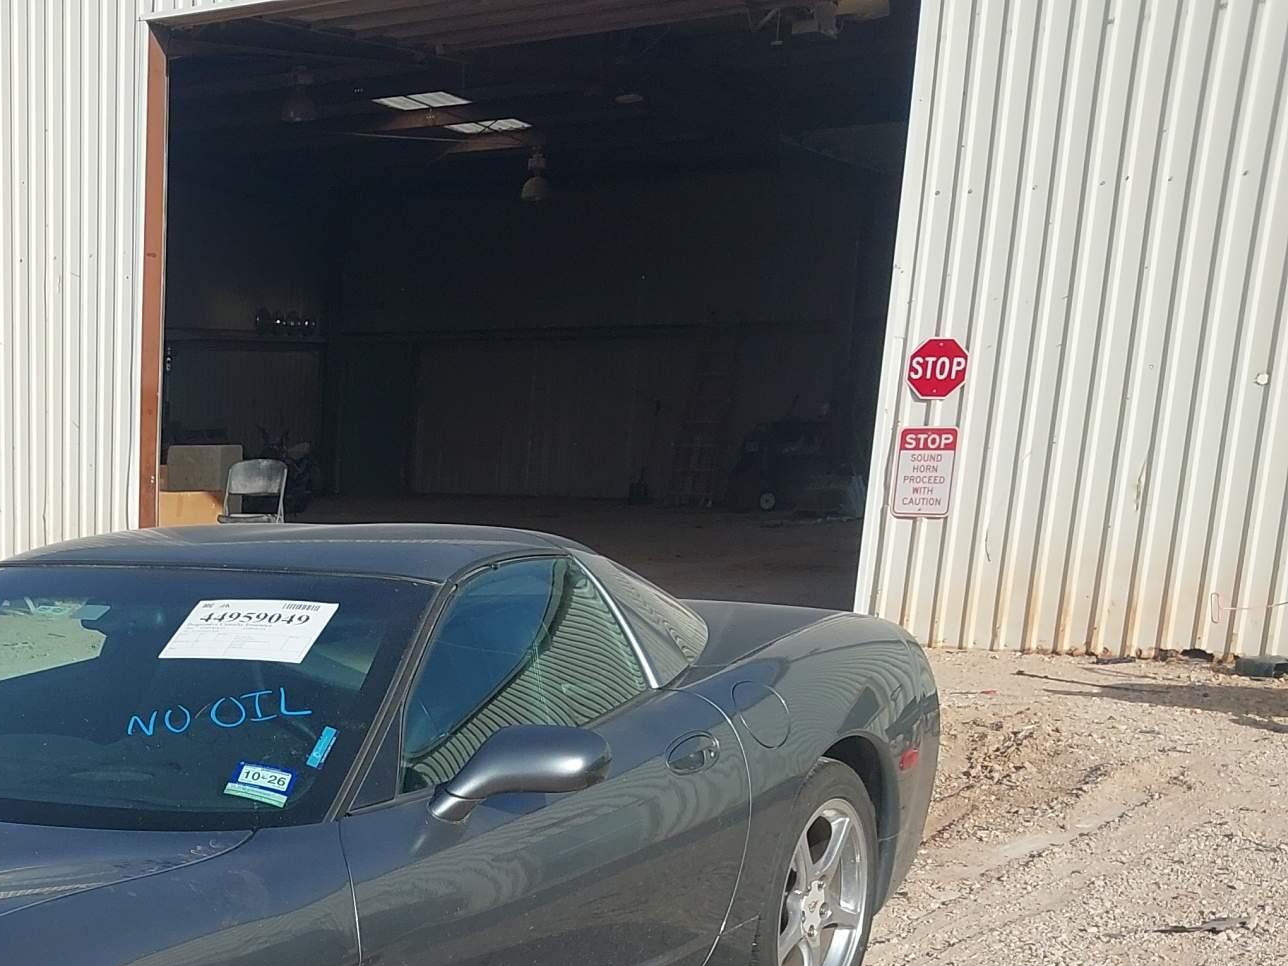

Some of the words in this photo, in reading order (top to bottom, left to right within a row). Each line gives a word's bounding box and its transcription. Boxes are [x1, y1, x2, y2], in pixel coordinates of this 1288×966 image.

[910, 356, 966, 380] STOP
[904, 433, 953, 449] STOP
[910, 454, 943, 462] SOUND
[912, 464, 938, 473] HORN
[903, 475, 945, 484] PROCEED
[912, 486, 934, 495] WITH
[902, 497, 941, 506] CAUTION
[199, 612, 310, 626] 44959049
[128, 705, 190, 736] NO
[211, 688, 312, 727] OIL
[244, 770, 287, 787] 10-26
